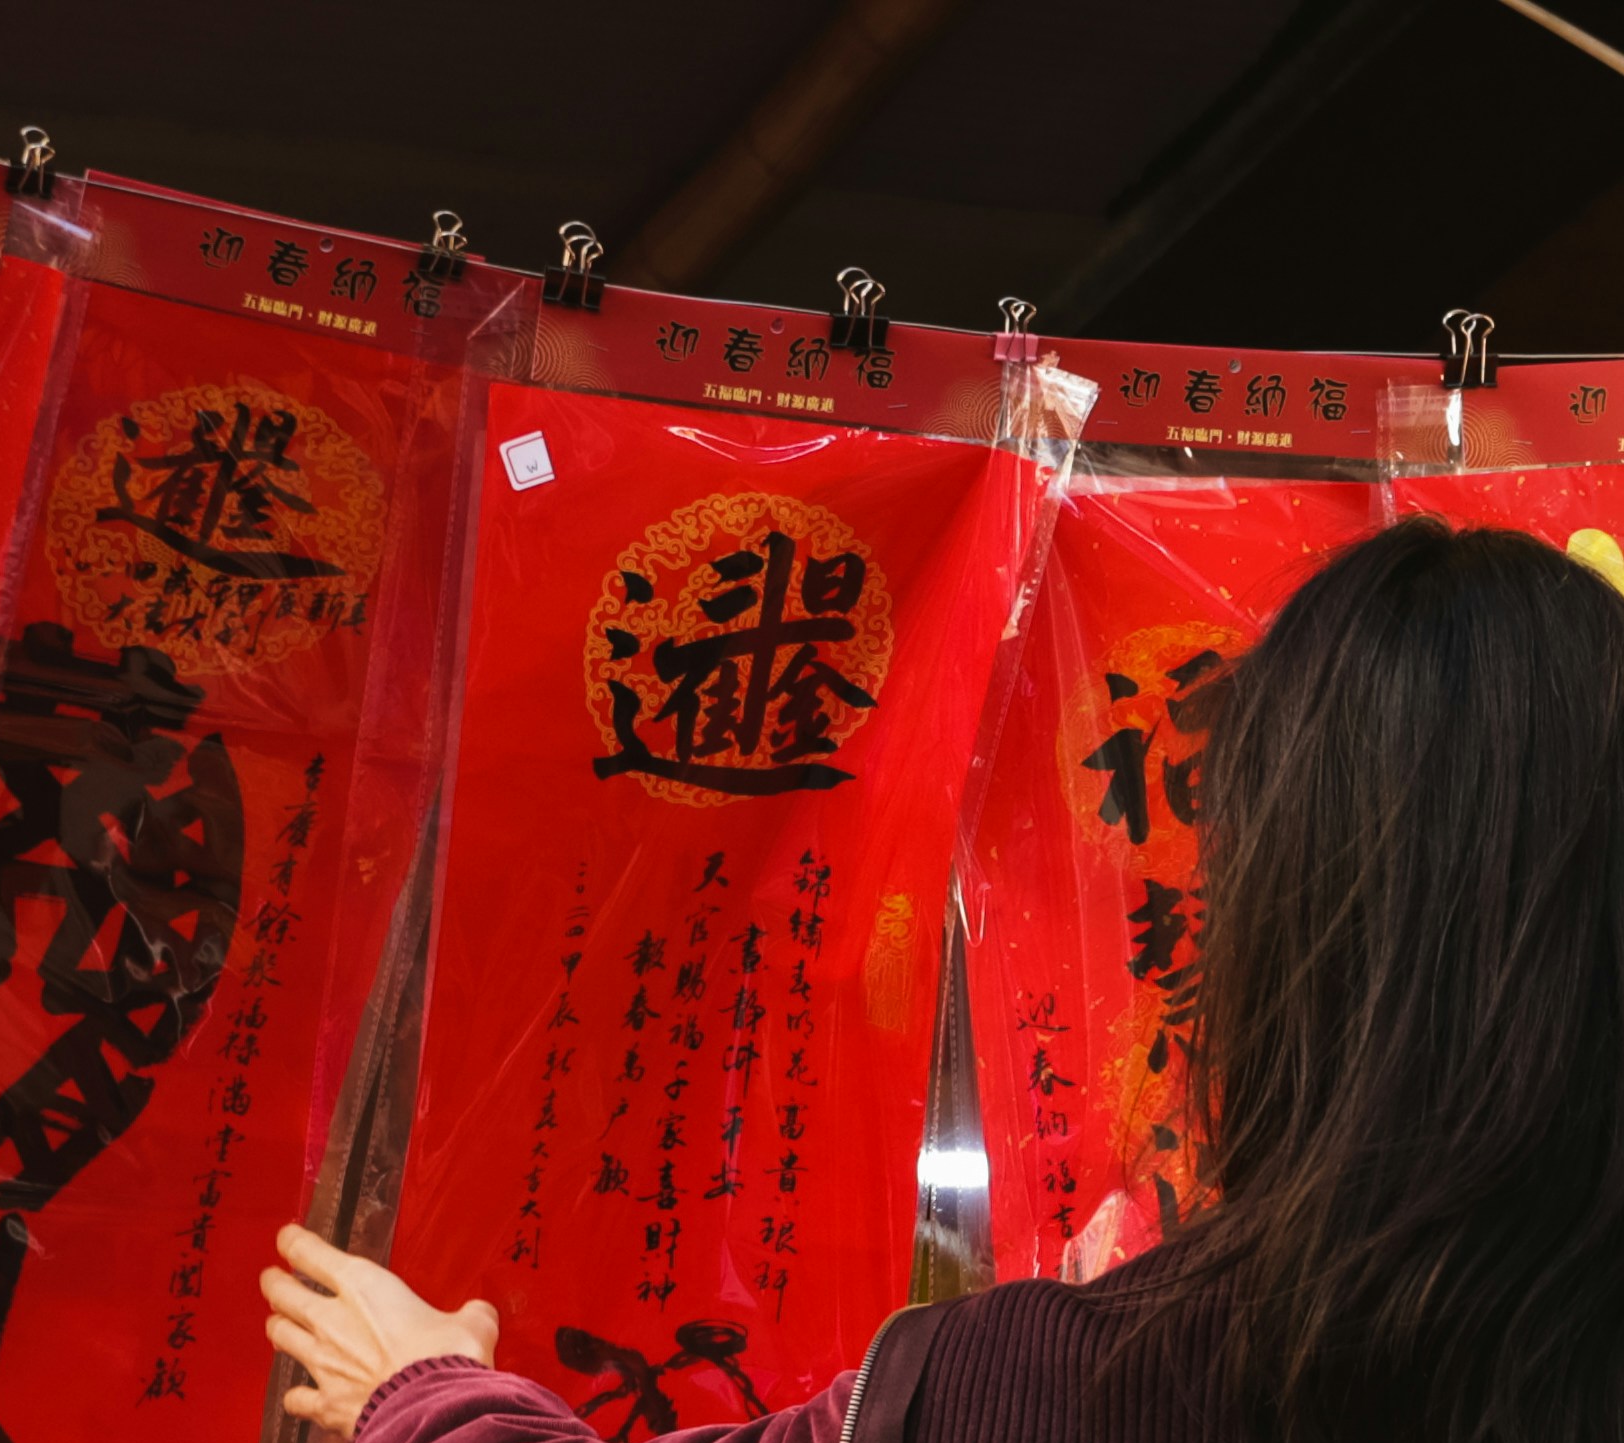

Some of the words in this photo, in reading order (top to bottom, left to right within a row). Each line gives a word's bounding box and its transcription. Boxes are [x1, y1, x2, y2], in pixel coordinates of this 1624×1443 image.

[199, 227, 446, 319] 迎春納福
[655, 321, 895, 389] 迎春納福
[1118, 367, 1349, 423] 迎春納福
